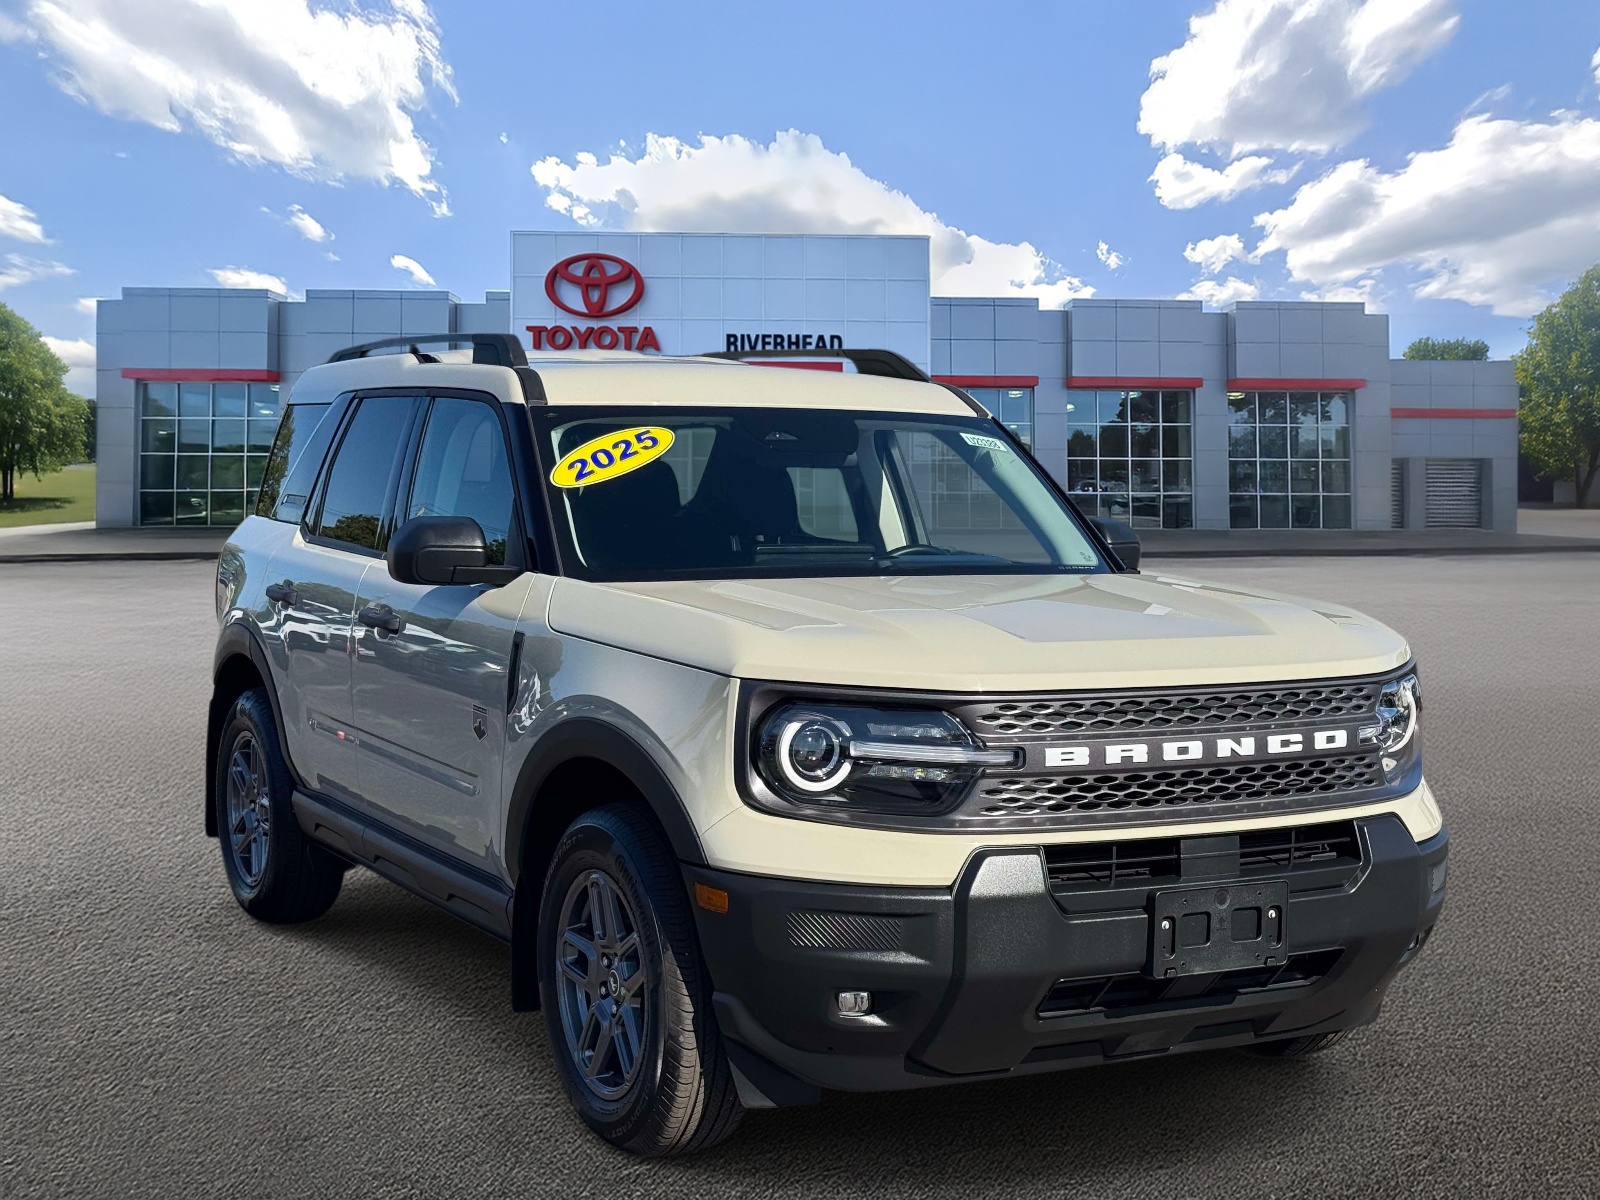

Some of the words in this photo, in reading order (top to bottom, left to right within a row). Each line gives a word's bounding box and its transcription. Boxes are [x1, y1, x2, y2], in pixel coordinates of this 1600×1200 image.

[525, 325, 661, 351] TOYOTA
[725, 333, 843, 352] RIVERHEAD
[567, 430, 659, 482] 2025
[1045, 730, 1347, 767] BRONCO
